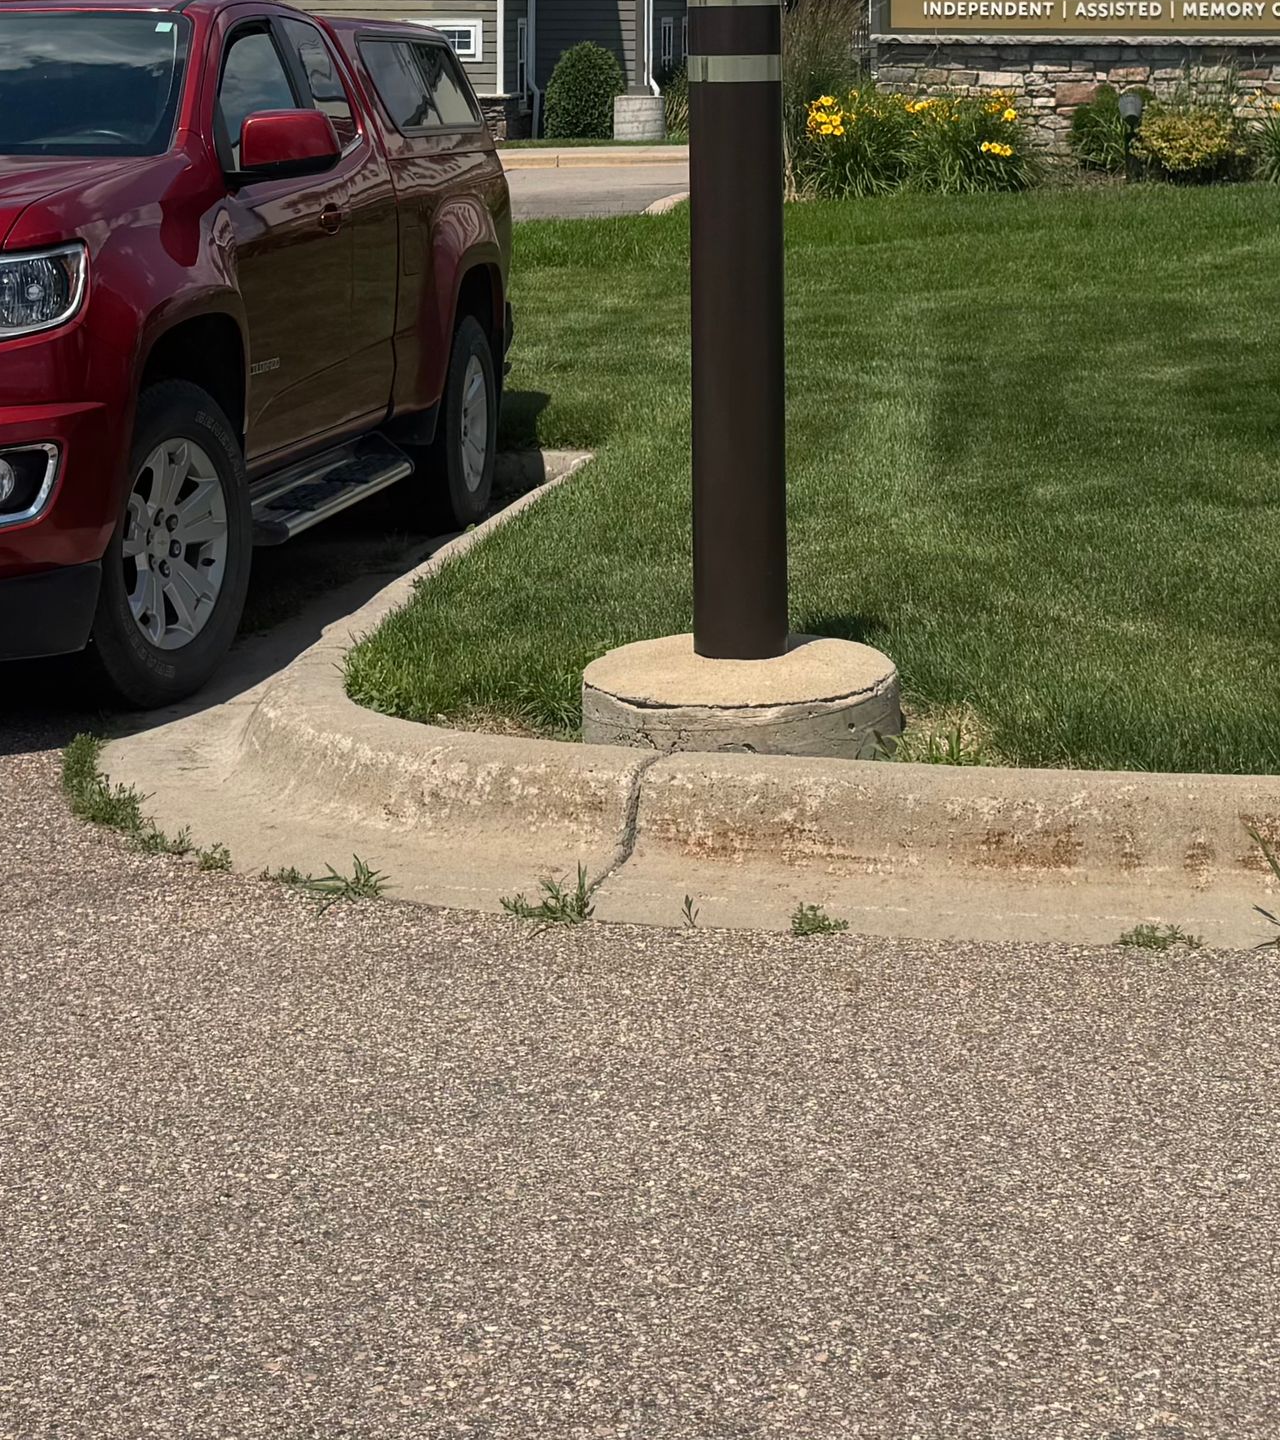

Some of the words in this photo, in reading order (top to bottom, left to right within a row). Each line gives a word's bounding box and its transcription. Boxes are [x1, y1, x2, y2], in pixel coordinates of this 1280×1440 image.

[923, 1, 1055, 17] INDEPENDENT
[1074, 1, 1162, 18] ASSISTED
[1182, 1, 1266, 18] MEMORY
